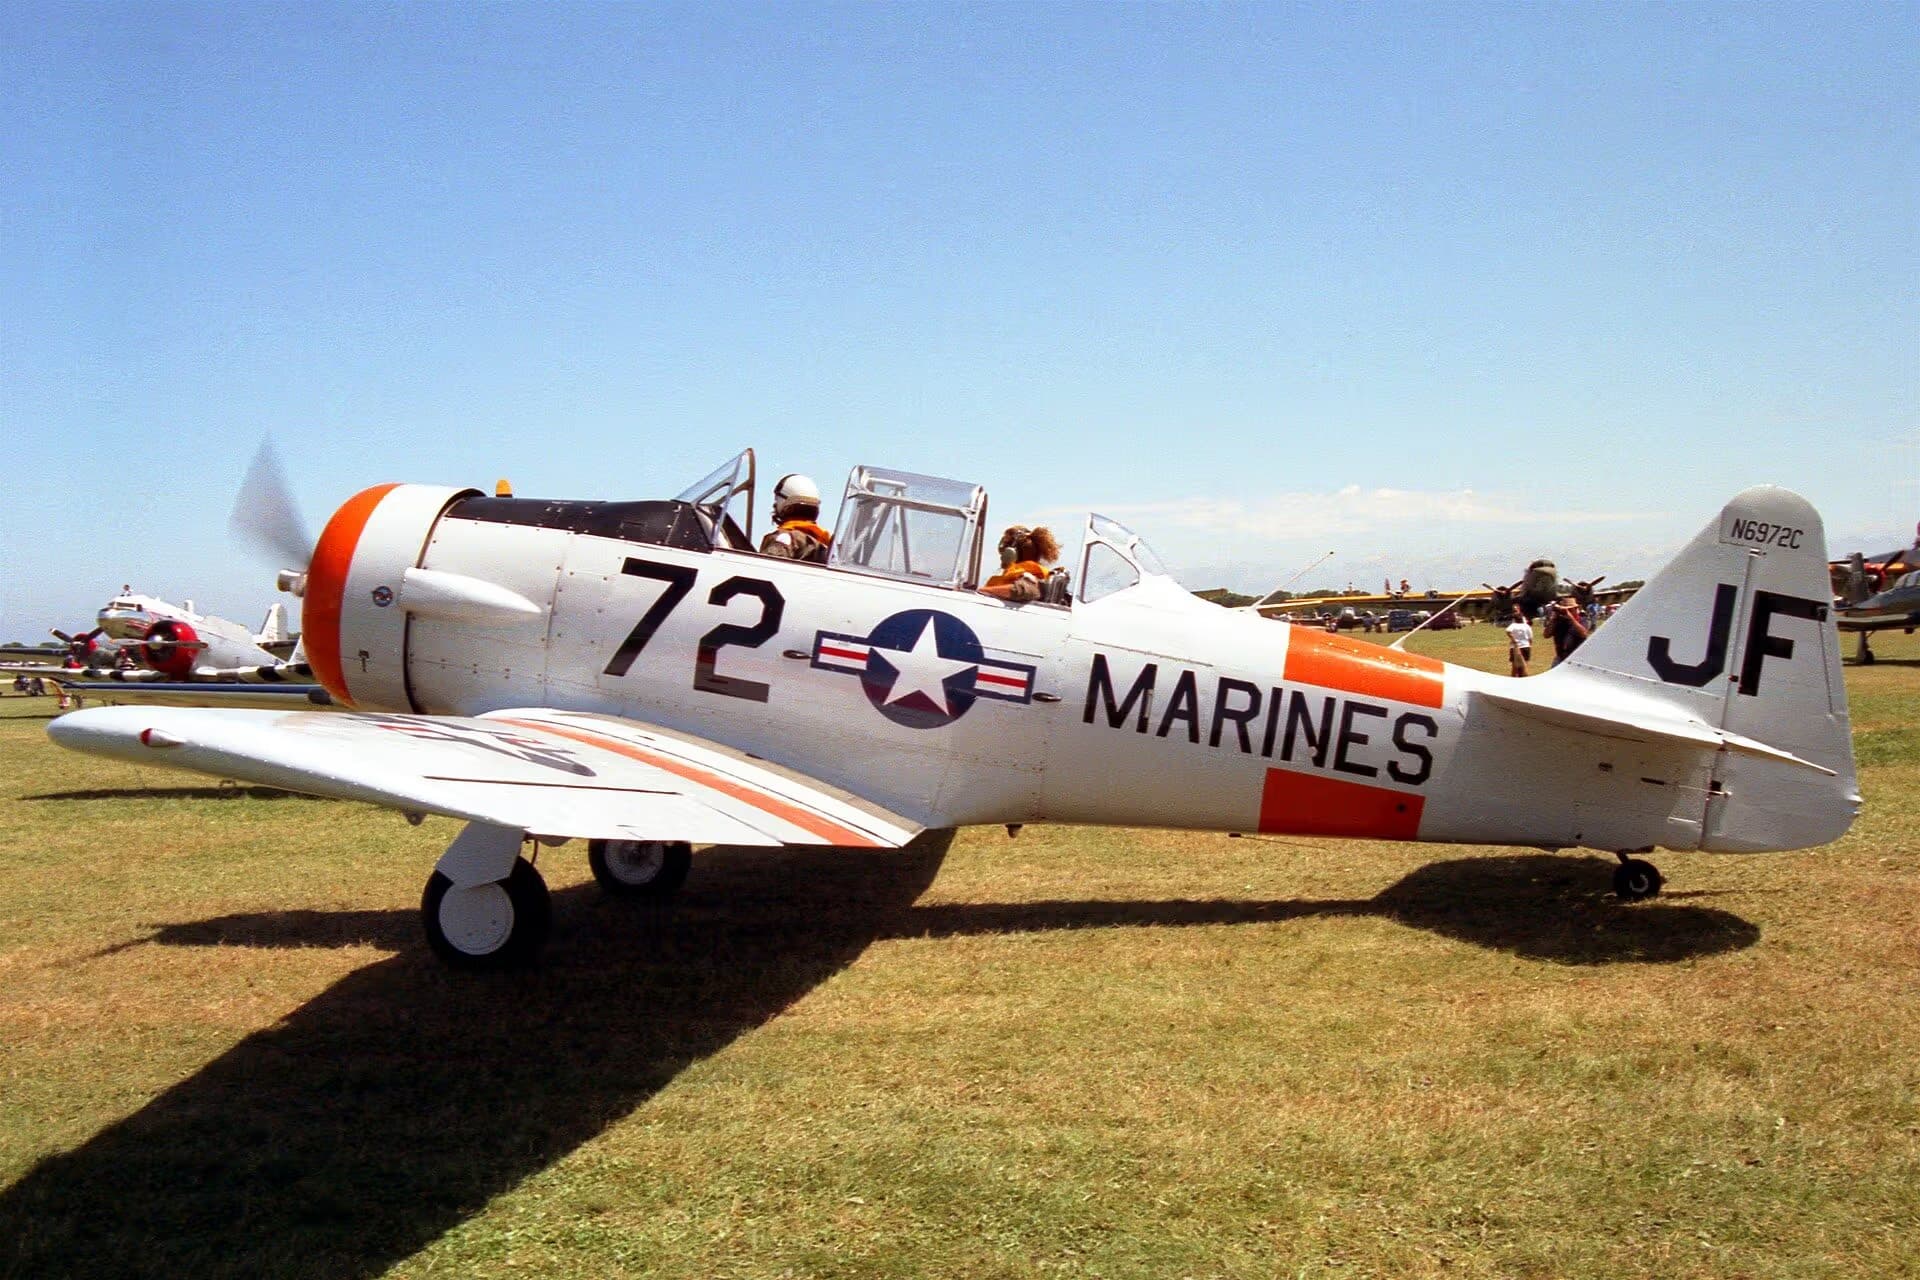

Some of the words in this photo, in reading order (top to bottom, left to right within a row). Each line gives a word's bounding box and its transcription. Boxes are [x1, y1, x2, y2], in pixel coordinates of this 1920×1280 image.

[1731, 518, 1804, 549] N6972C
[603, 557, 786, 703] 72
[1647, 583, 1829, 697] JF
[1083, 653, 1438, 786] MARINES
